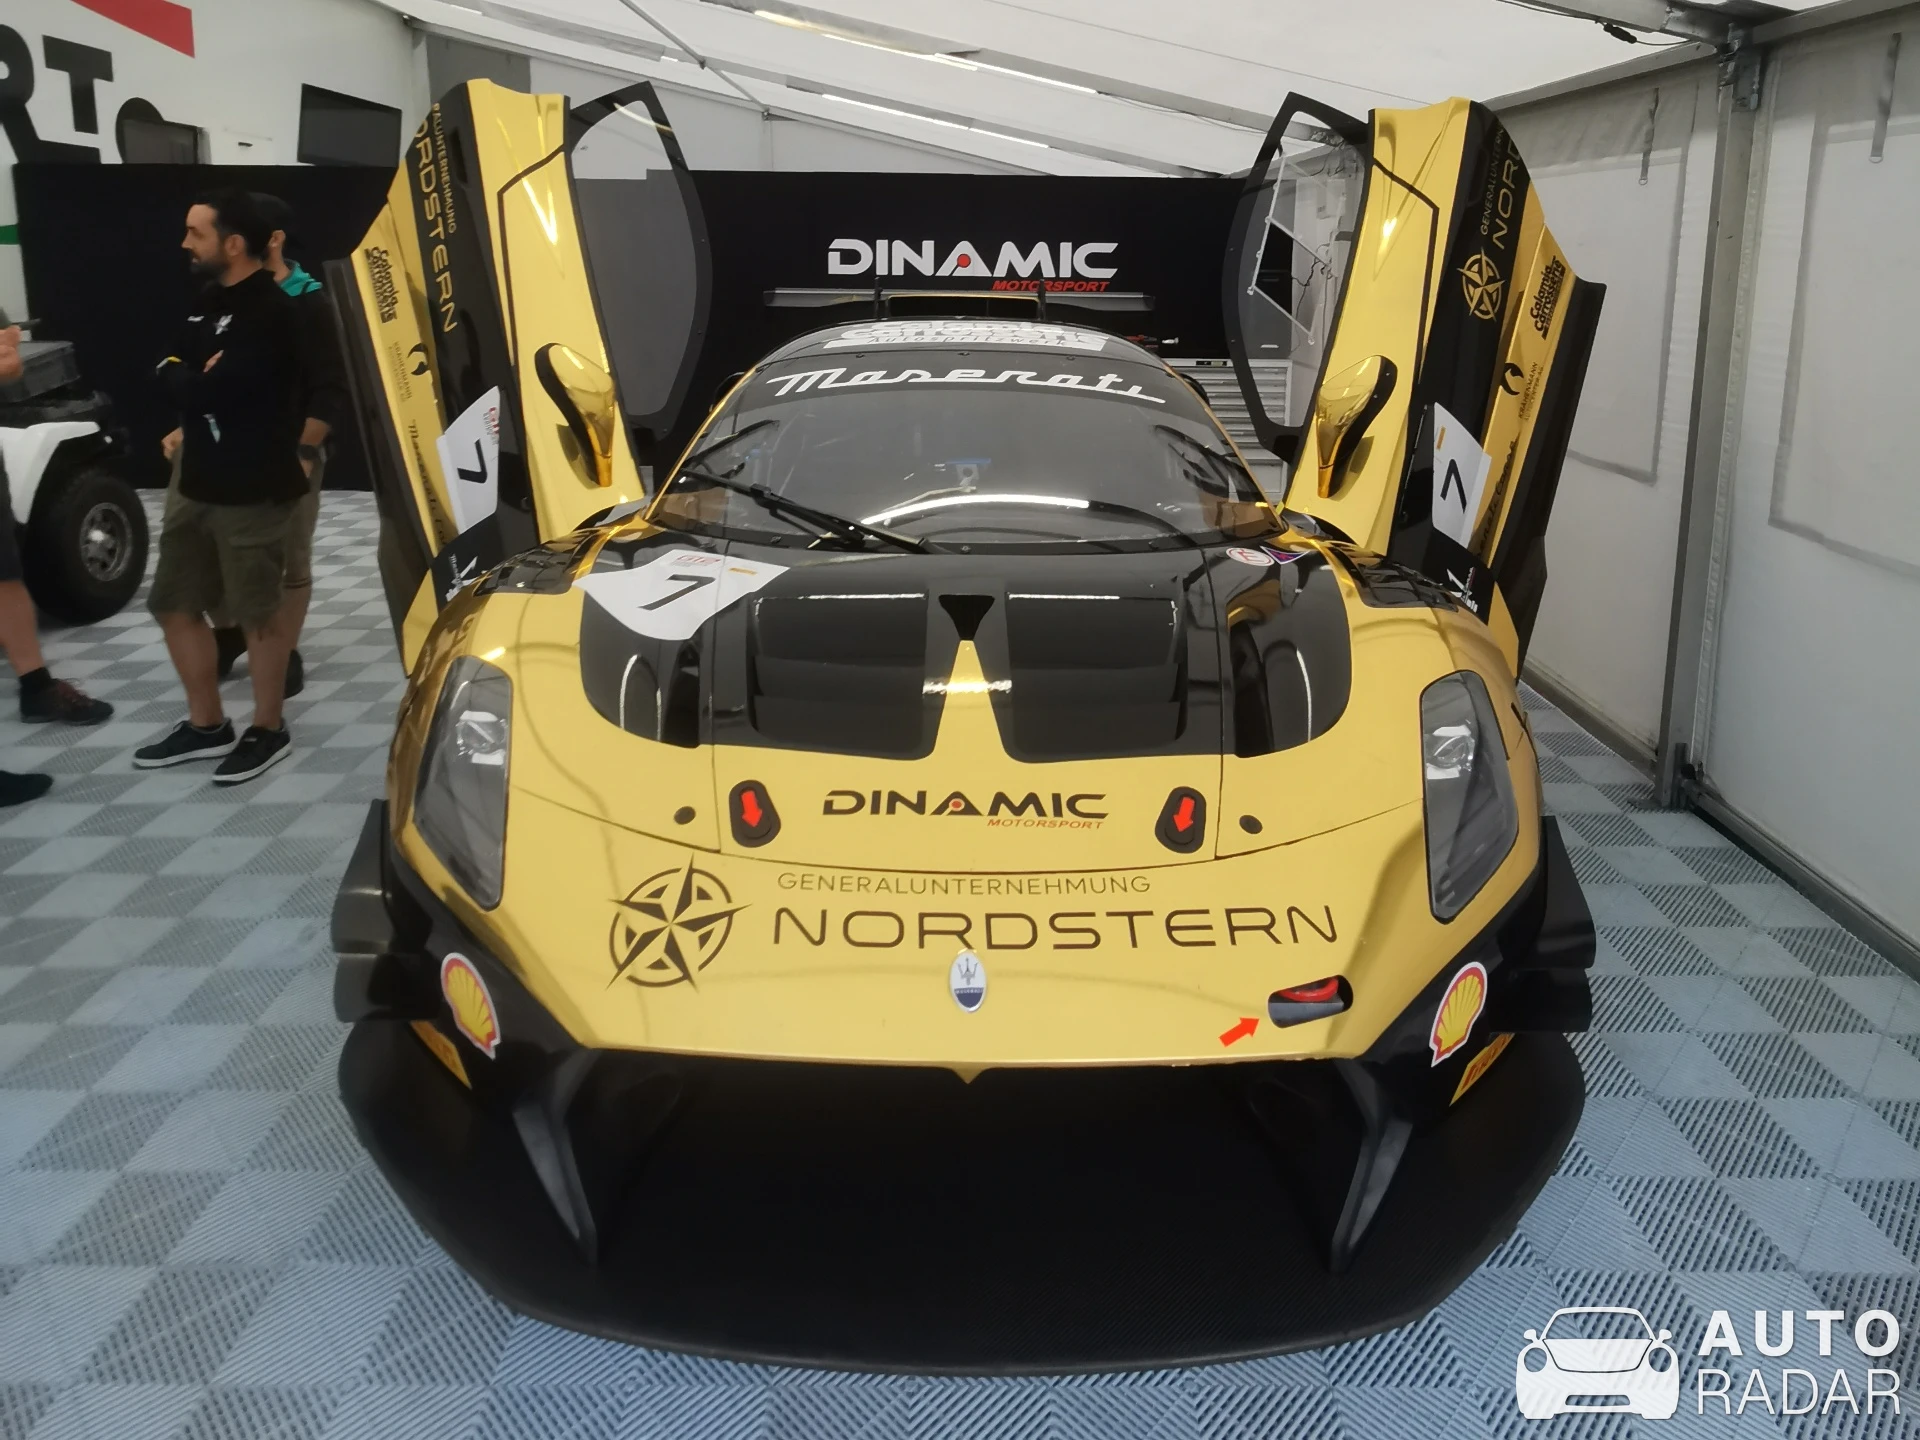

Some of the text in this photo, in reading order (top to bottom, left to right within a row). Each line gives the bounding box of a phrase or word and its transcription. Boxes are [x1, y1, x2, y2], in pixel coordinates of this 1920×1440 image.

[828, 238, 1119, 279] DINAMIC
[992, 280, 1110, 292] MOTORSPORT
[766, 367, 1166, 404] Maserati
[456, 437, 488, 484] 7
[1439, 458, 1468, 515] 7
[637, 573, 717, 611] 7
[822, 789, 1110, 820] DINAMIC
[986, 817, 1105, 831] MOTORSPORT
[777, 872, 1151, 896] GENERALUNTERNEHMUNG
[773, 904, 1338, 951] NORDSTERN
